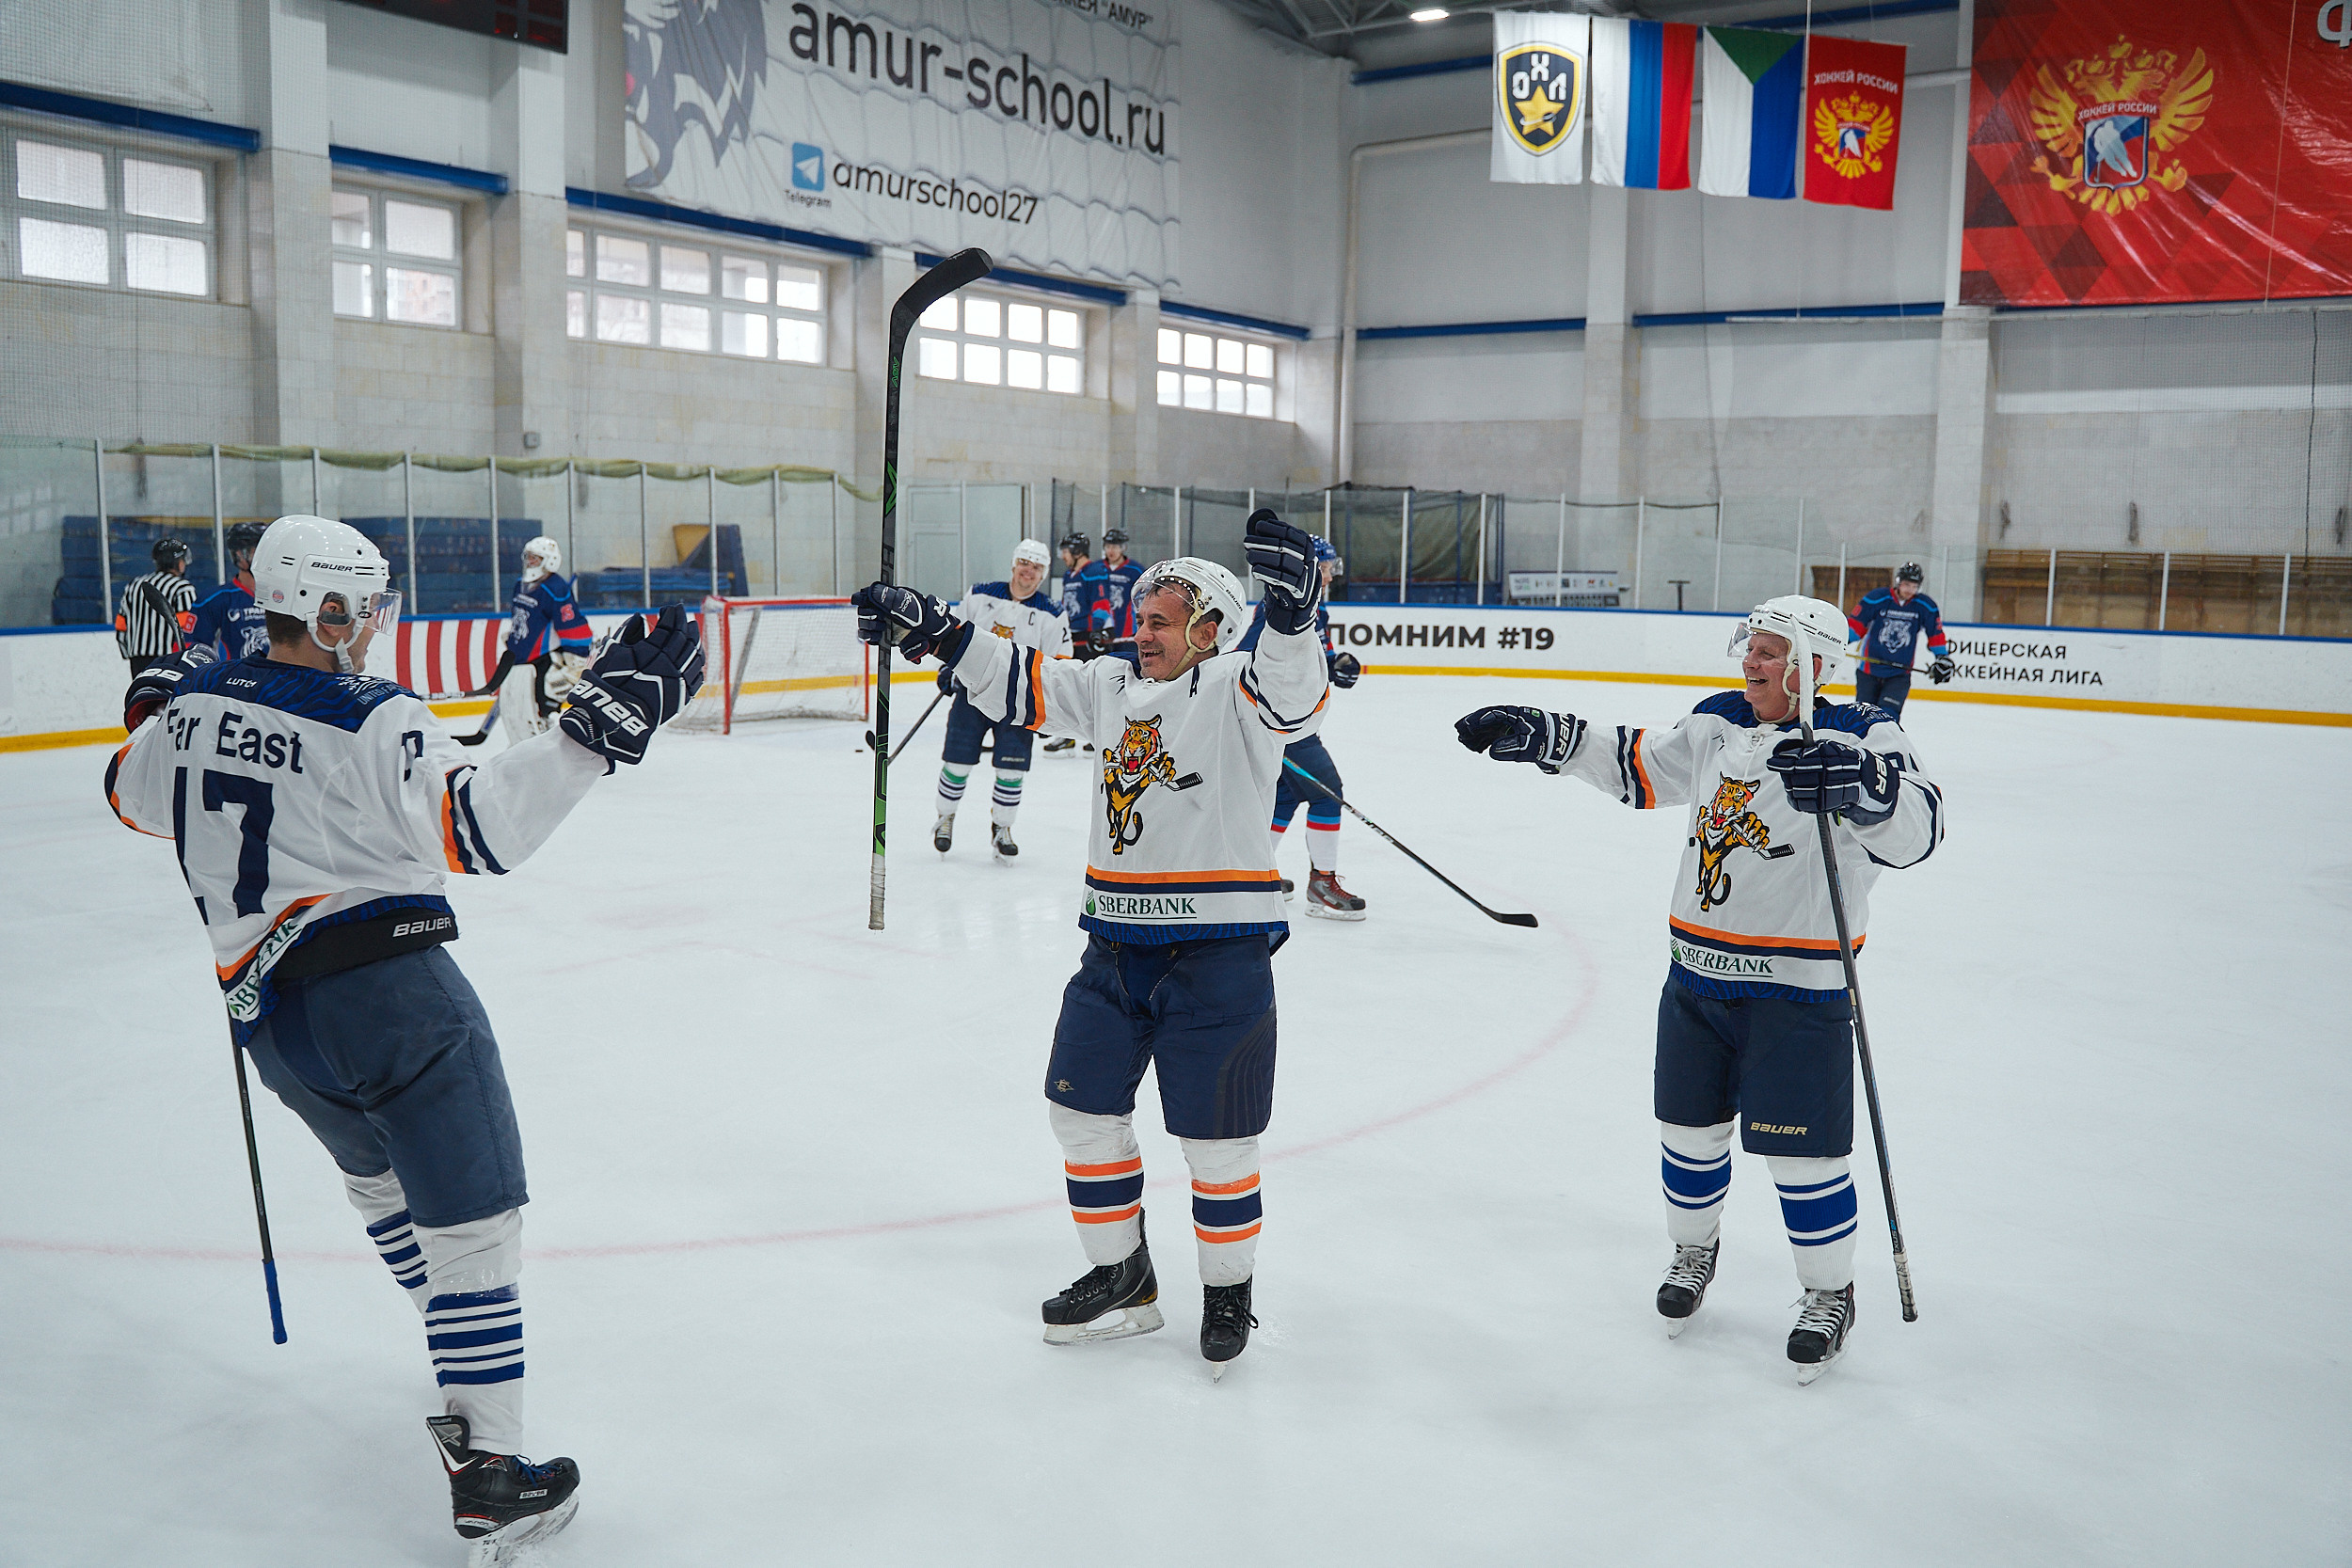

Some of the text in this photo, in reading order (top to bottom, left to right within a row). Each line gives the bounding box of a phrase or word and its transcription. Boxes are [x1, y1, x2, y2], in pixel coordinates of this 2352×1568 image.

[789, 2, 1165, 155] amur-school.ru
[1814, 69, 1899, 94] ХОККЕЙ РОССИИ
[2078, 102, 2157, 119] ХОККЕЙ РОССИИ
[784, 189, 832, 208] Telegram
[834, 162, 1039, 224] amurschool27
[1327, 623, 1554, 651] ПОМНИМ #19
[227, 677, 258, 689] LUTCH
[2050, 670, 2103, 686] ЛИГА
[167, 708, 304, 774] Far East
[1099, 895, 1197, 915] SBERBANK
[1681, 945, 1773, 974] SBERBANK
